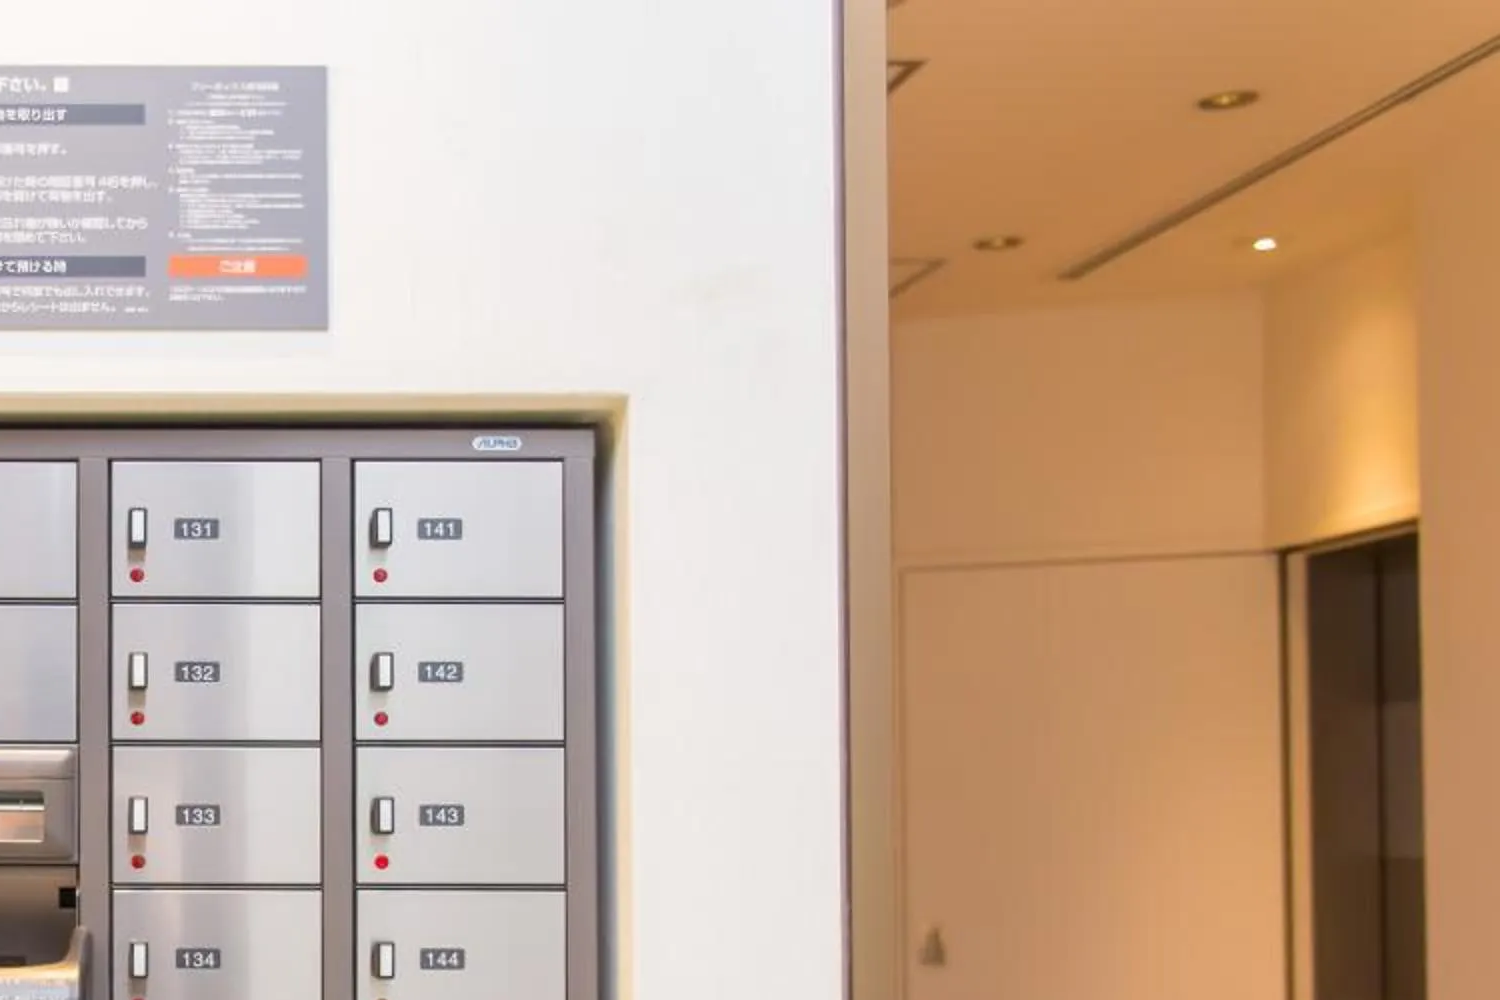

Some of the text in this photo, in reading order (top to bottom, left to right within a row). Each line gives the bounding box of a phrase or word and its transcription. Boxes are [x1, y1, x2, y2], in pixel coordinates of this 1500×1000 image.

[181, 521, 211, 536] 131
[424, 521, 455, 537] 141
[181, 665, 214, 681] 132
[425, 664, 457, 680] 142
[182, 807, 215, 823] 133
[425, 807, 459, 824] 143
[183, 951, 215, 967] 134
[427, 951, 459, 967] 144
